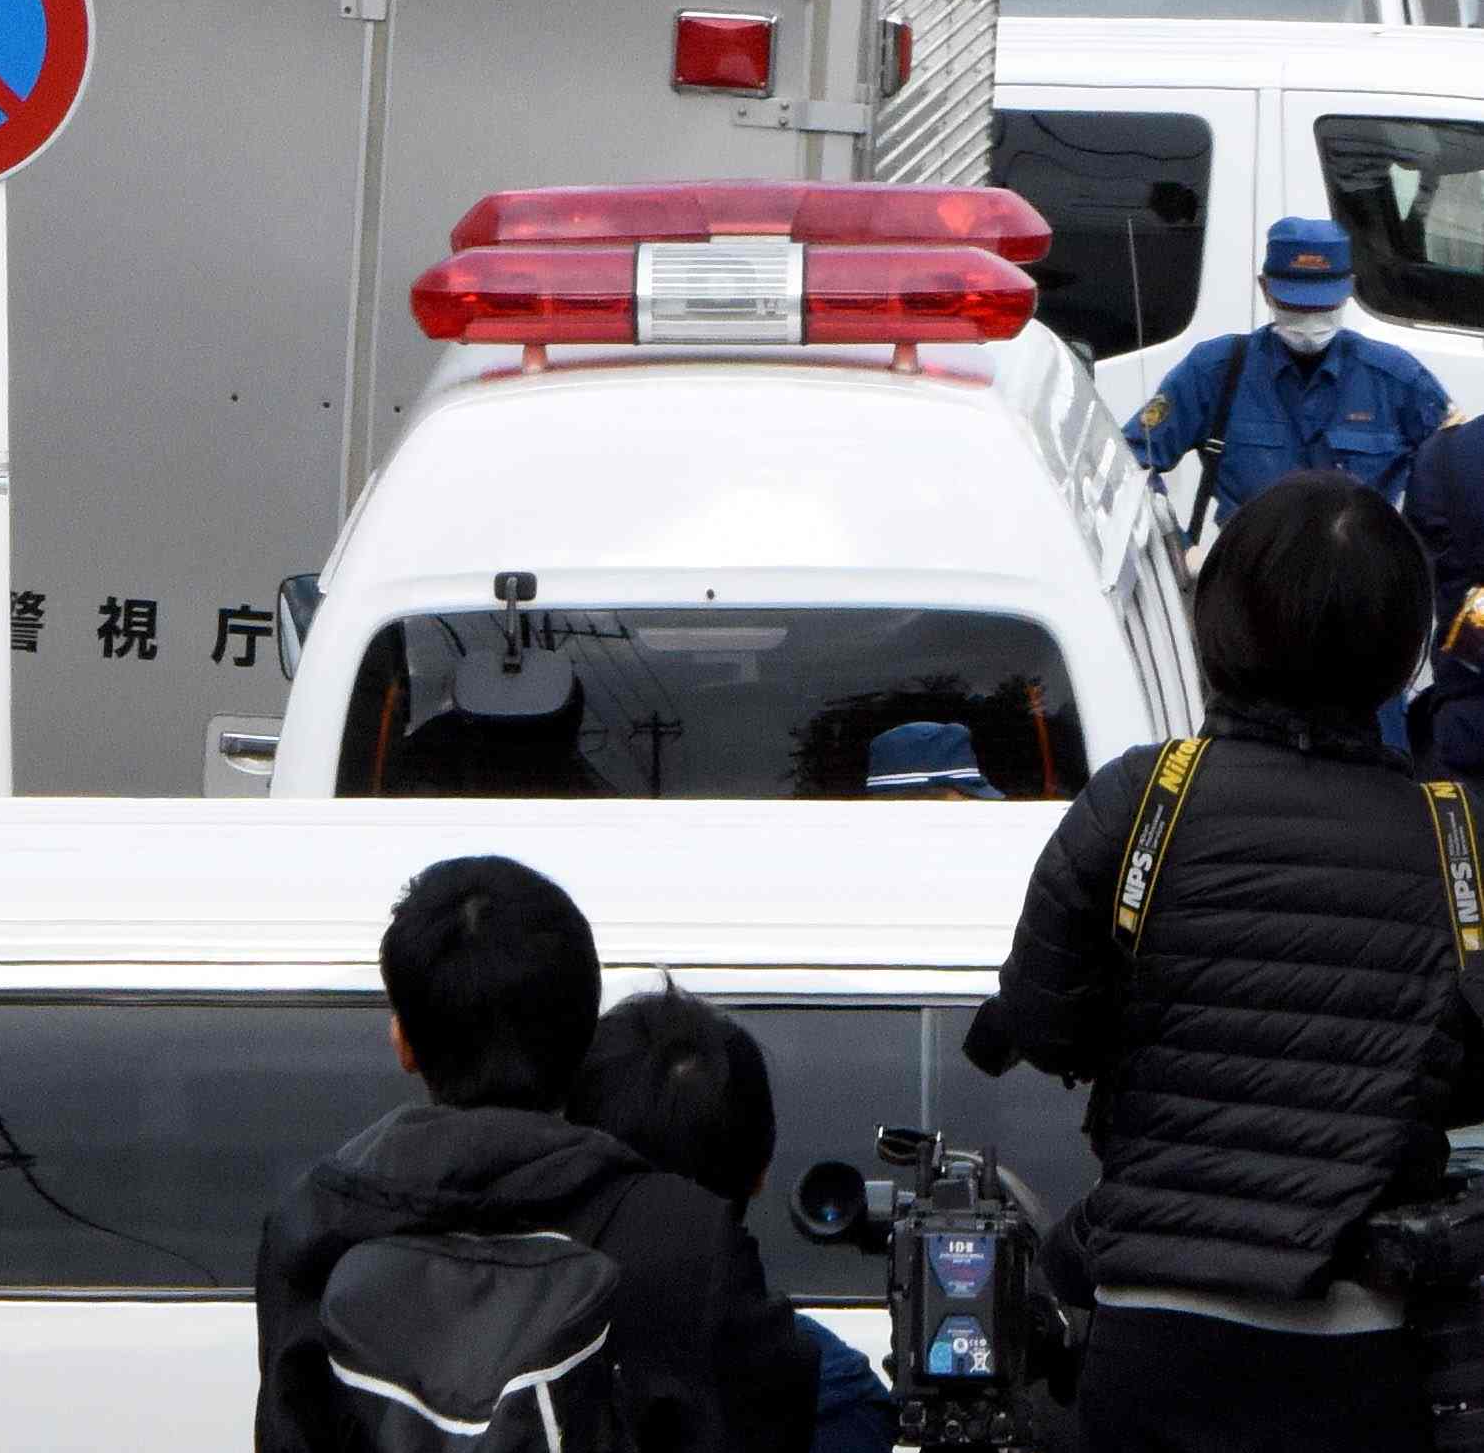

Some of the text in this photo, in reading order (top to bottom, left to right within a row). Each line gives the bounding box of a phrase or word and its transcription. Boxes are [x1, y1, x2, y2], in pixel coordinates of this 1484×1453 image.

[10, 590, 273, 667] 警視庁
[1159, 737, 1203, 792] Niko
[1123, 850, 1154, 909] NPS
[1450, 861, 1480, 923] NPS
